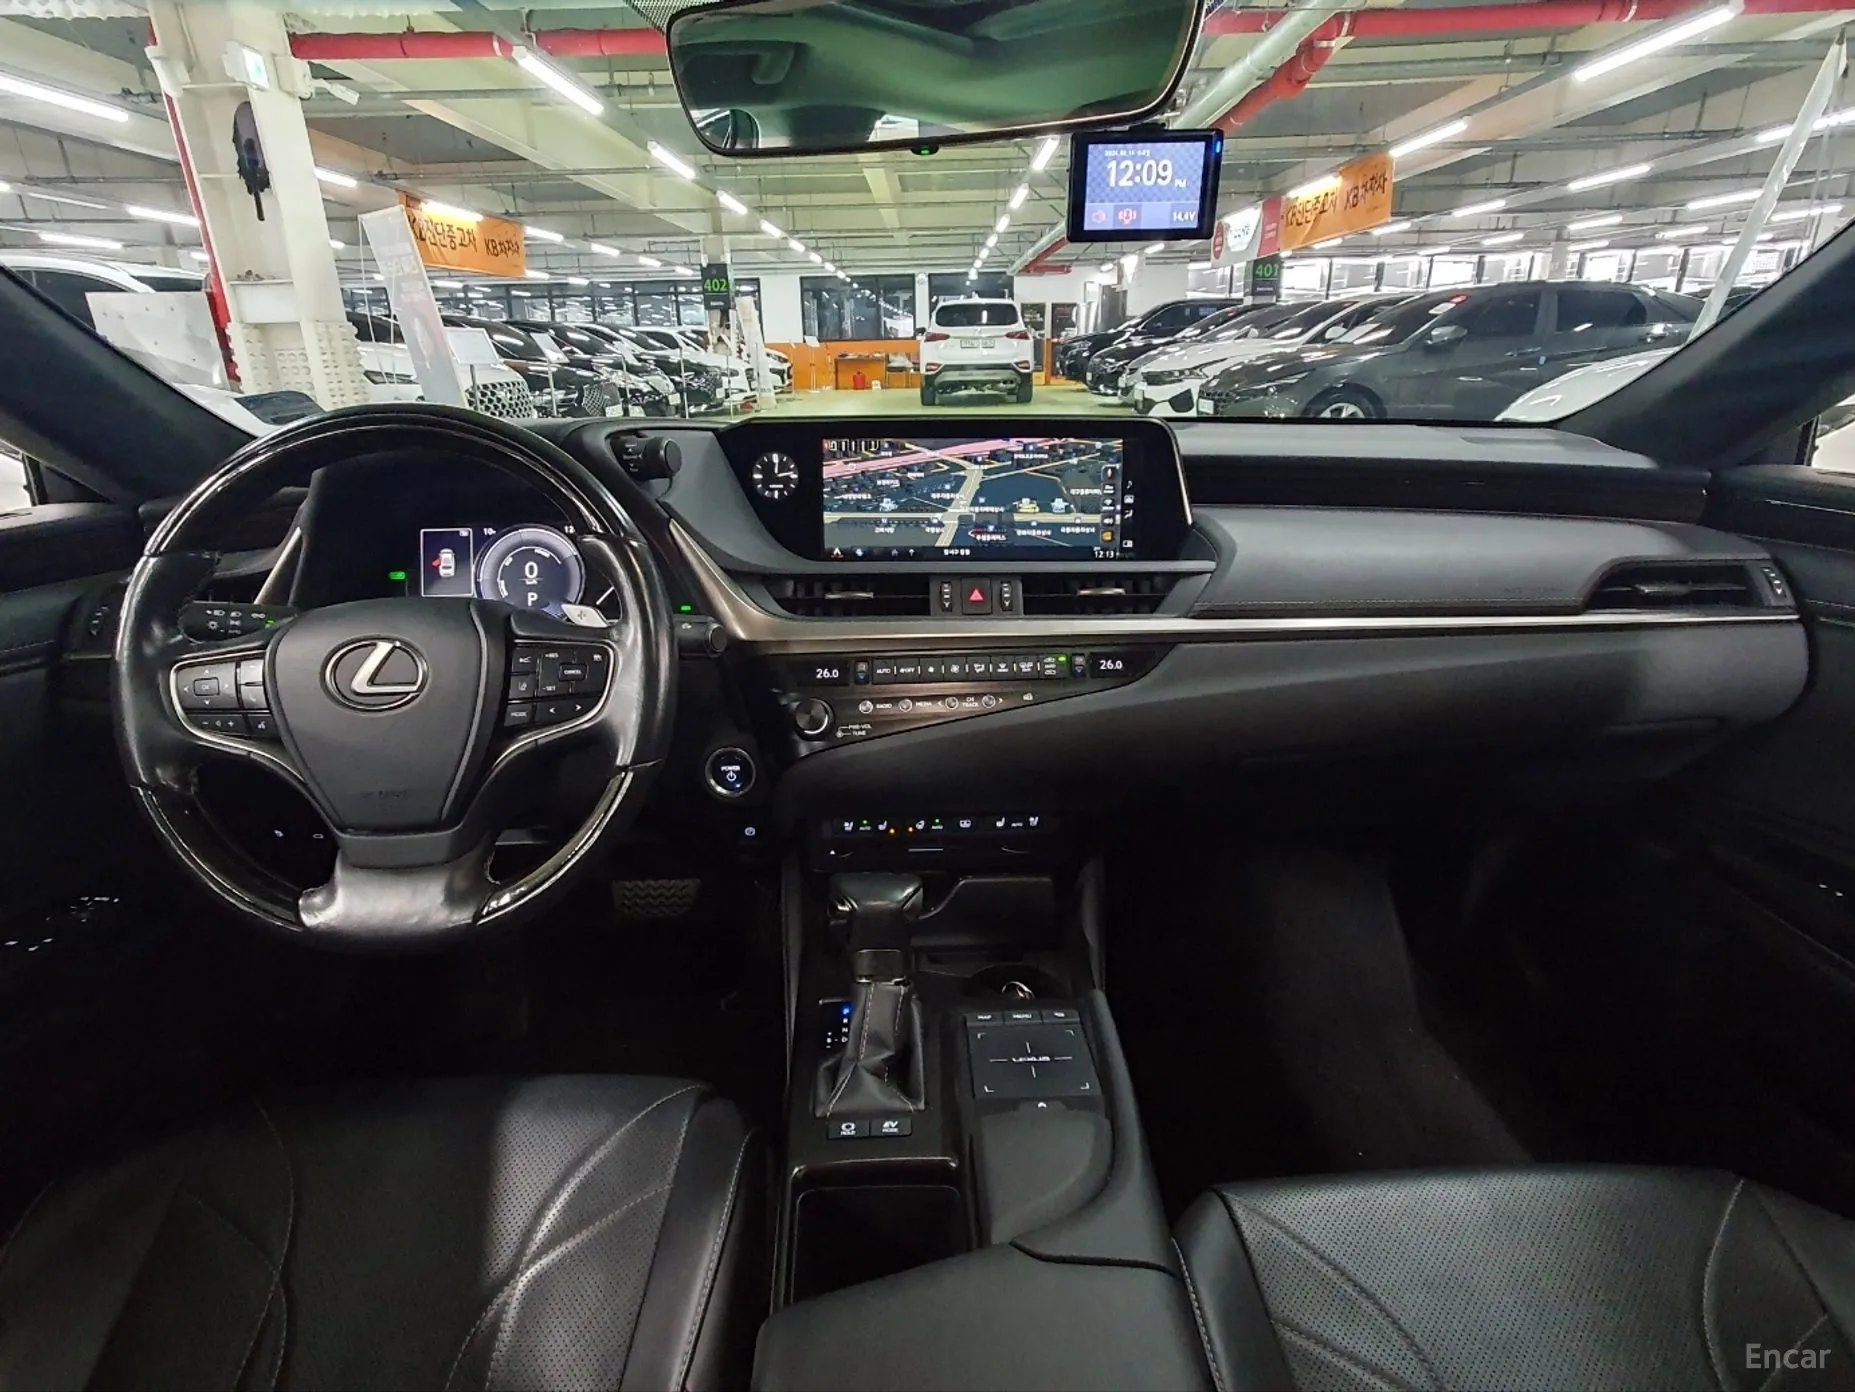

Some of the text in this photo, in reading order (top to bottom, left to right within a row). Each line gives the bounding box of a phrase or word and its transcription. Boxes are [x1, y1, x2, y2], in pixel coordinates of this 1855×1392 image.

[1107, 159, 1173, 187] 12:09
[1255, 264, 1279, 277] 401
[704, 279, 727, 291] 402
[525, 561, 538, 578] 0
[527, 592, 538, 606] P
[1100, 660, 1123, 670] 26.0
[816, 668, 839, 678] 26.0
